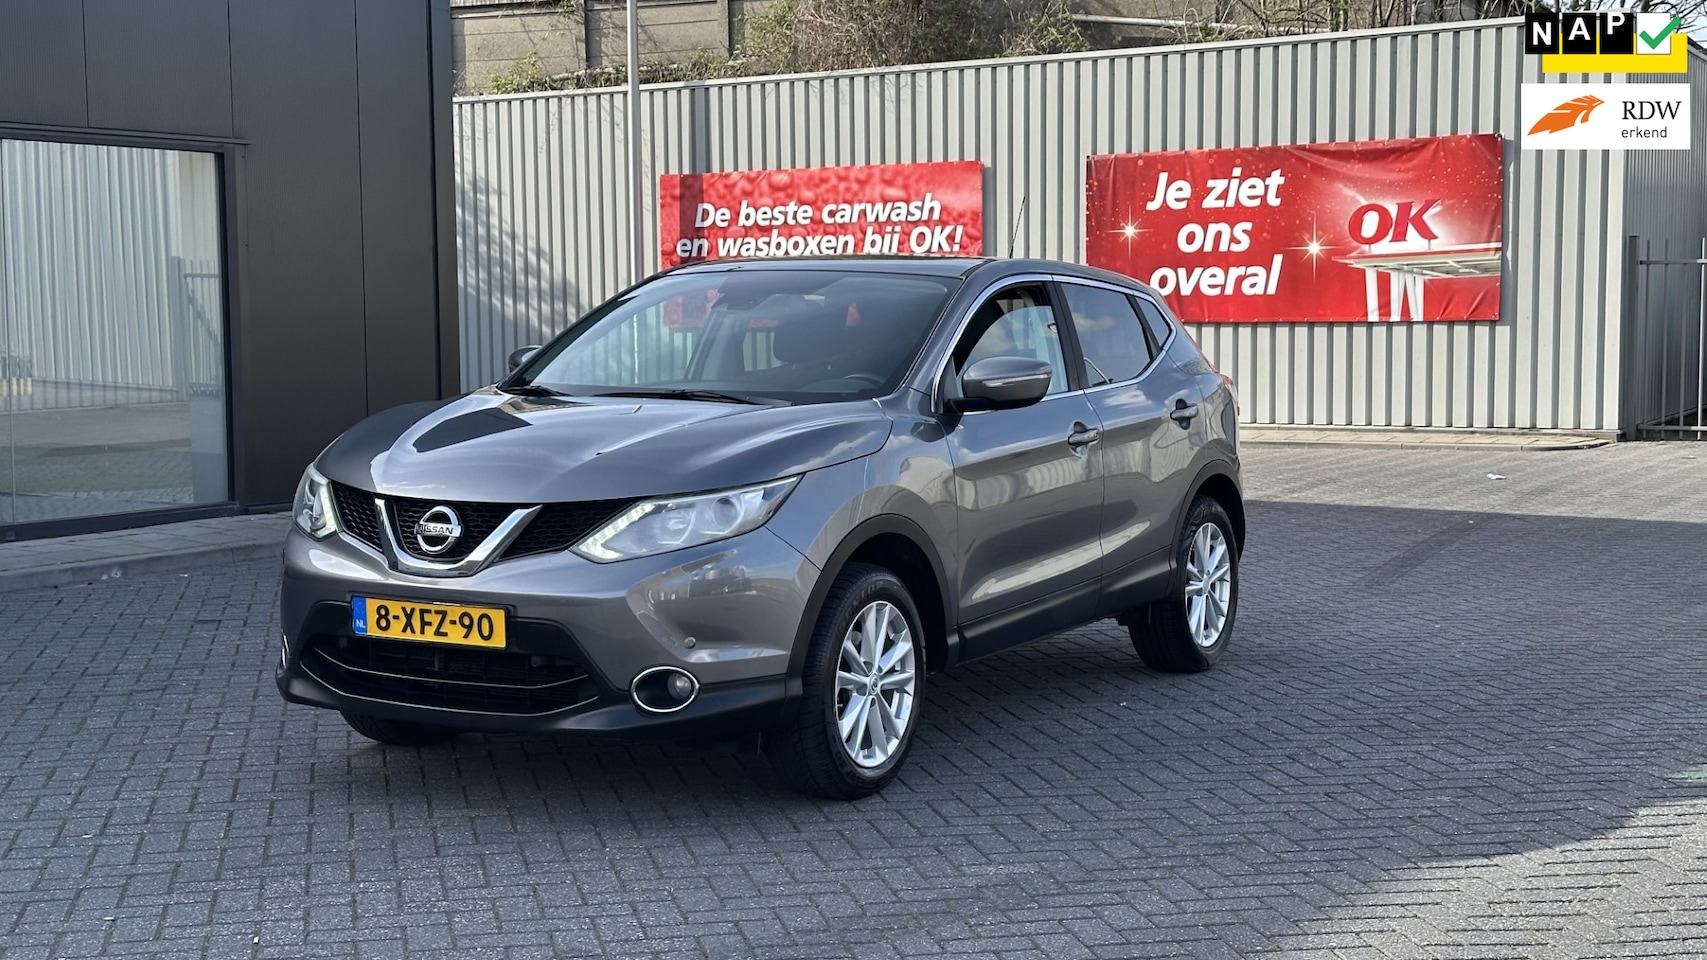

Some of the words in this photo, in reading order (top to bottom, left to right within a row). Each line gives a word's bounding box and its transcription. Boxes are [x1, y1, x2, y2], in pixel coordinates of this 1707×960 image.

[1145, 171, 1192, 211] Je
[1201, 166, 1286, 209] ziet
[694, 203, 731, 228] De
[737, 200, 813, 227] beste
[821, 193, 942, 224] carwash
[1347, 199, 1442, 245] OK
[675, 237, 709, 257] en
[717, 229, 855, 257] wasboxen
[909, 225, 964, 254] OK!
[1176, 220, 1253, 254] ons
[1149, 254, 1284, 297] overal
[419, 523, 454, 535] NISSAN
[355, 619, 366, 629] NL
[375, 604, 494, 641] 8-XFZ-90
